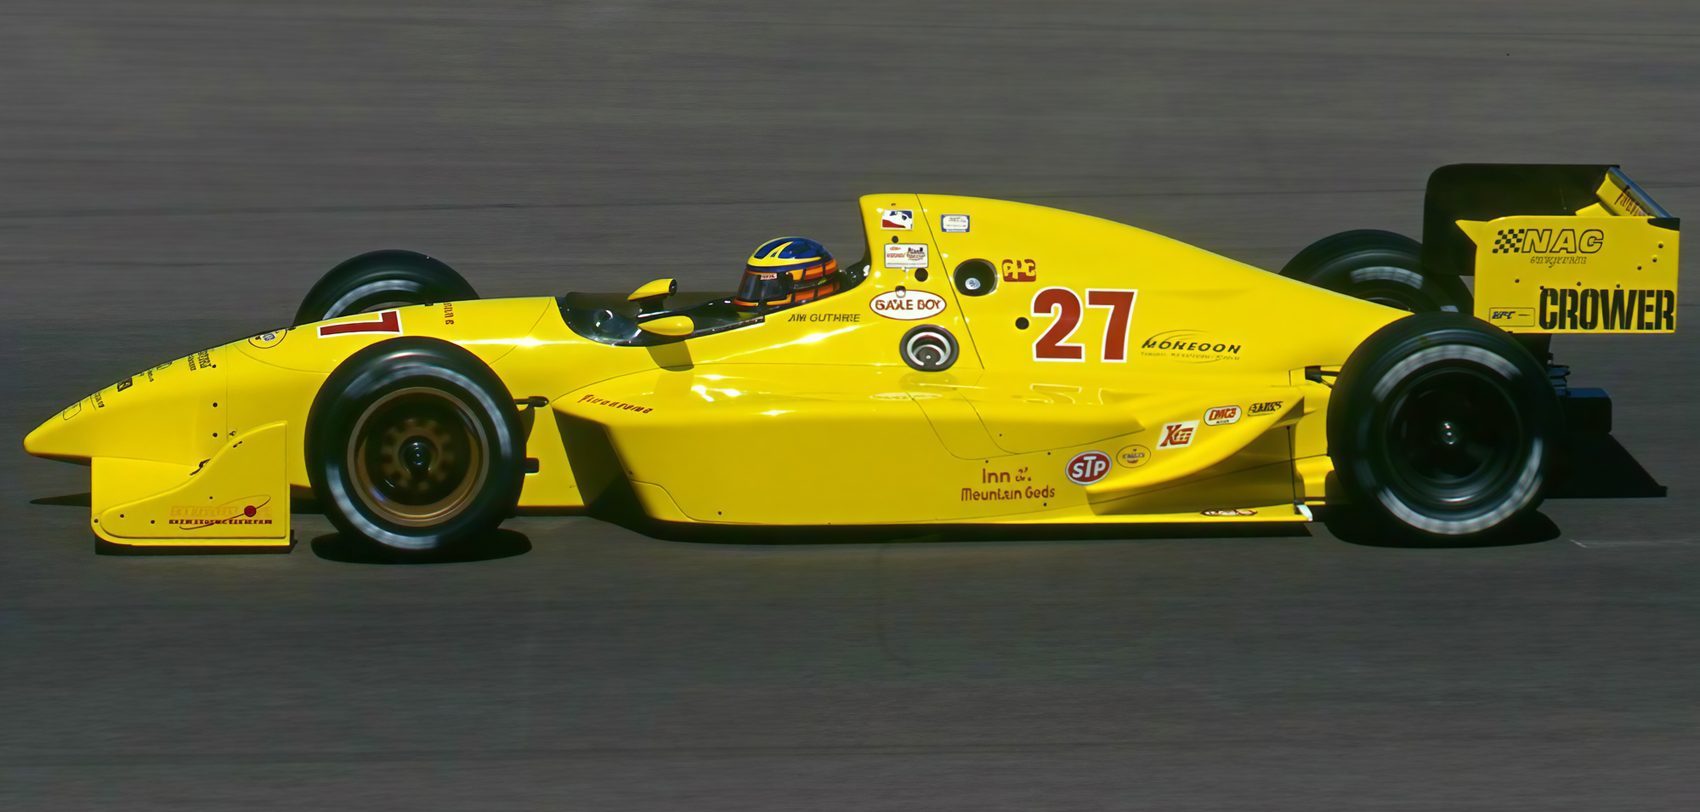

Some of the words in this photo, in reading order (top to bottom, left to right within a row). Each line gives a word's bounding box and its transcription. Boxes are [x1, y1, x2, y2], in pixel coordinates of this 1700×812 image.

[1521, 228, 1605, 254] NAC
[917, 298, 942, 310] BOY
[1538, 287, 1676, 331] CROWER
[809, 313, 861, 323] GUTHRIE
[1031, 287, 1137, 362] 27
[982, 467, 1011, 484] Inn
[1072, 456, 1107, 479] STP
